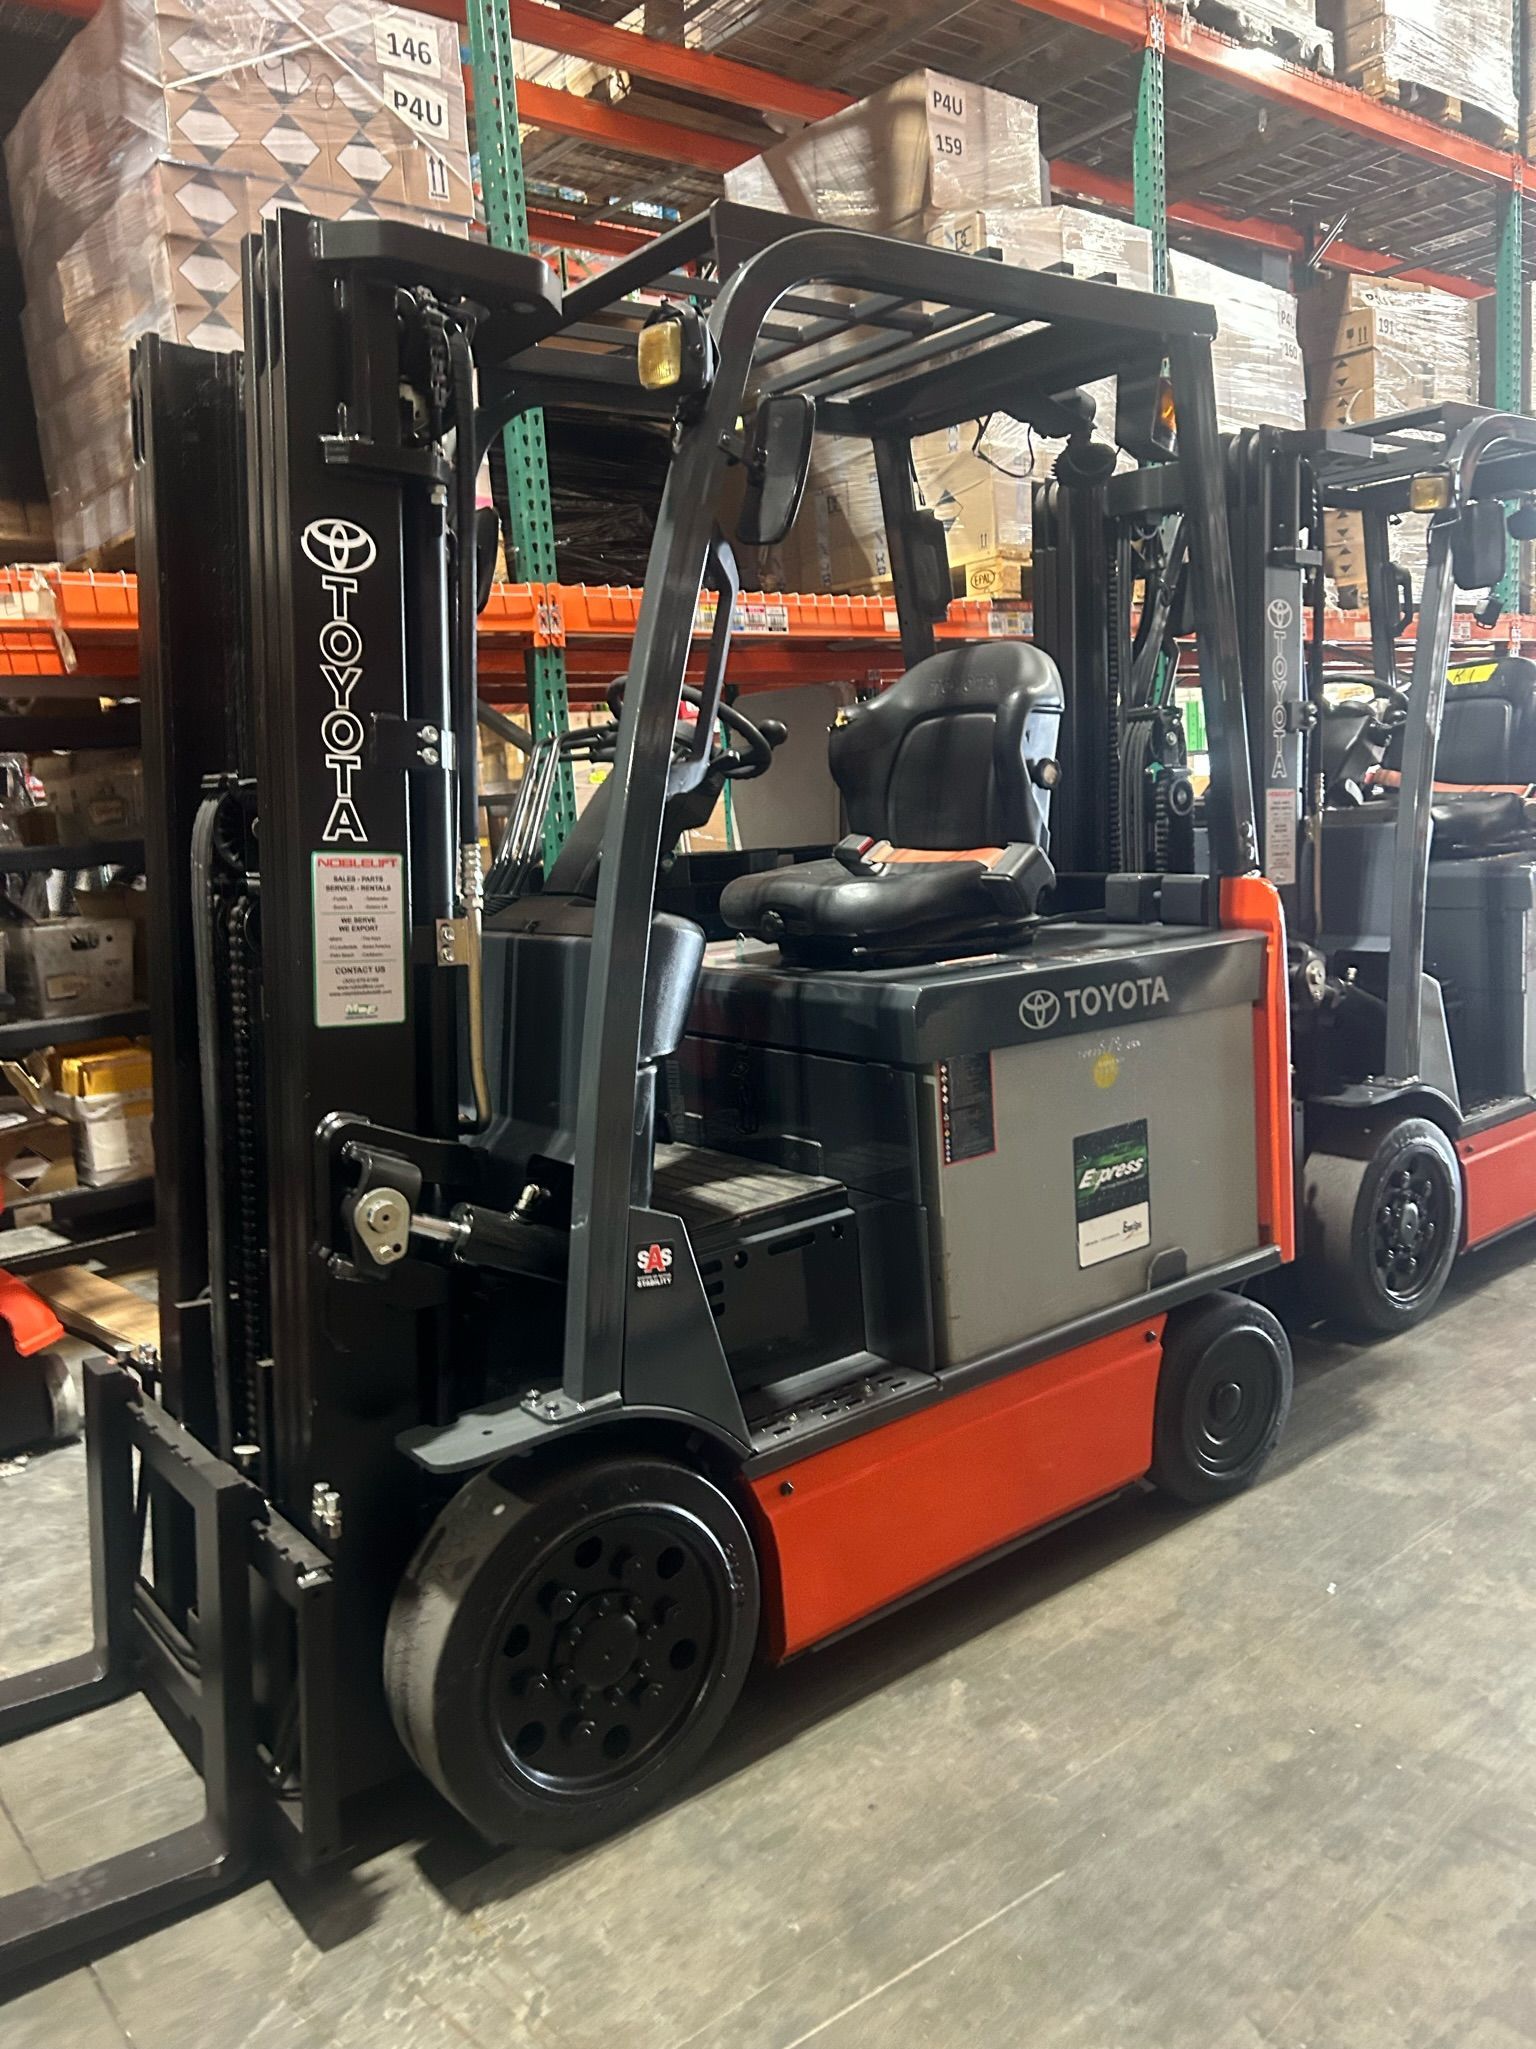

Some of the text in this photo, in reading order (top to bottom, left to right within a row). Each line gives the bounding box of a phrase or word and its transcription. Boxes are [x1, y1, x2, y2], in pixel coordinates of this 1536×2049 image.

[387, 32, 432, 65] 146
[394, 89, 442, 126] P4U
[933, 90, 963, 116] P4U
[936, 134, 962, 155] 159
[1379, 318, 1395, 335] 191
[320, 574, 368, 842] TOYOTA
[1271, 630, 1288, 779] TOYOTA
[325, 884, 392, 892] SERVICE RENTALS
[333, 875, 384, 883] SALES PARTS
[353, 916, 377, 924] SERVE
[334, 965, 386, 975] CONTACT US
[1064, 976, 1169, 1019] TOYOTA
[637, 1243, 673, 1273] SAS
